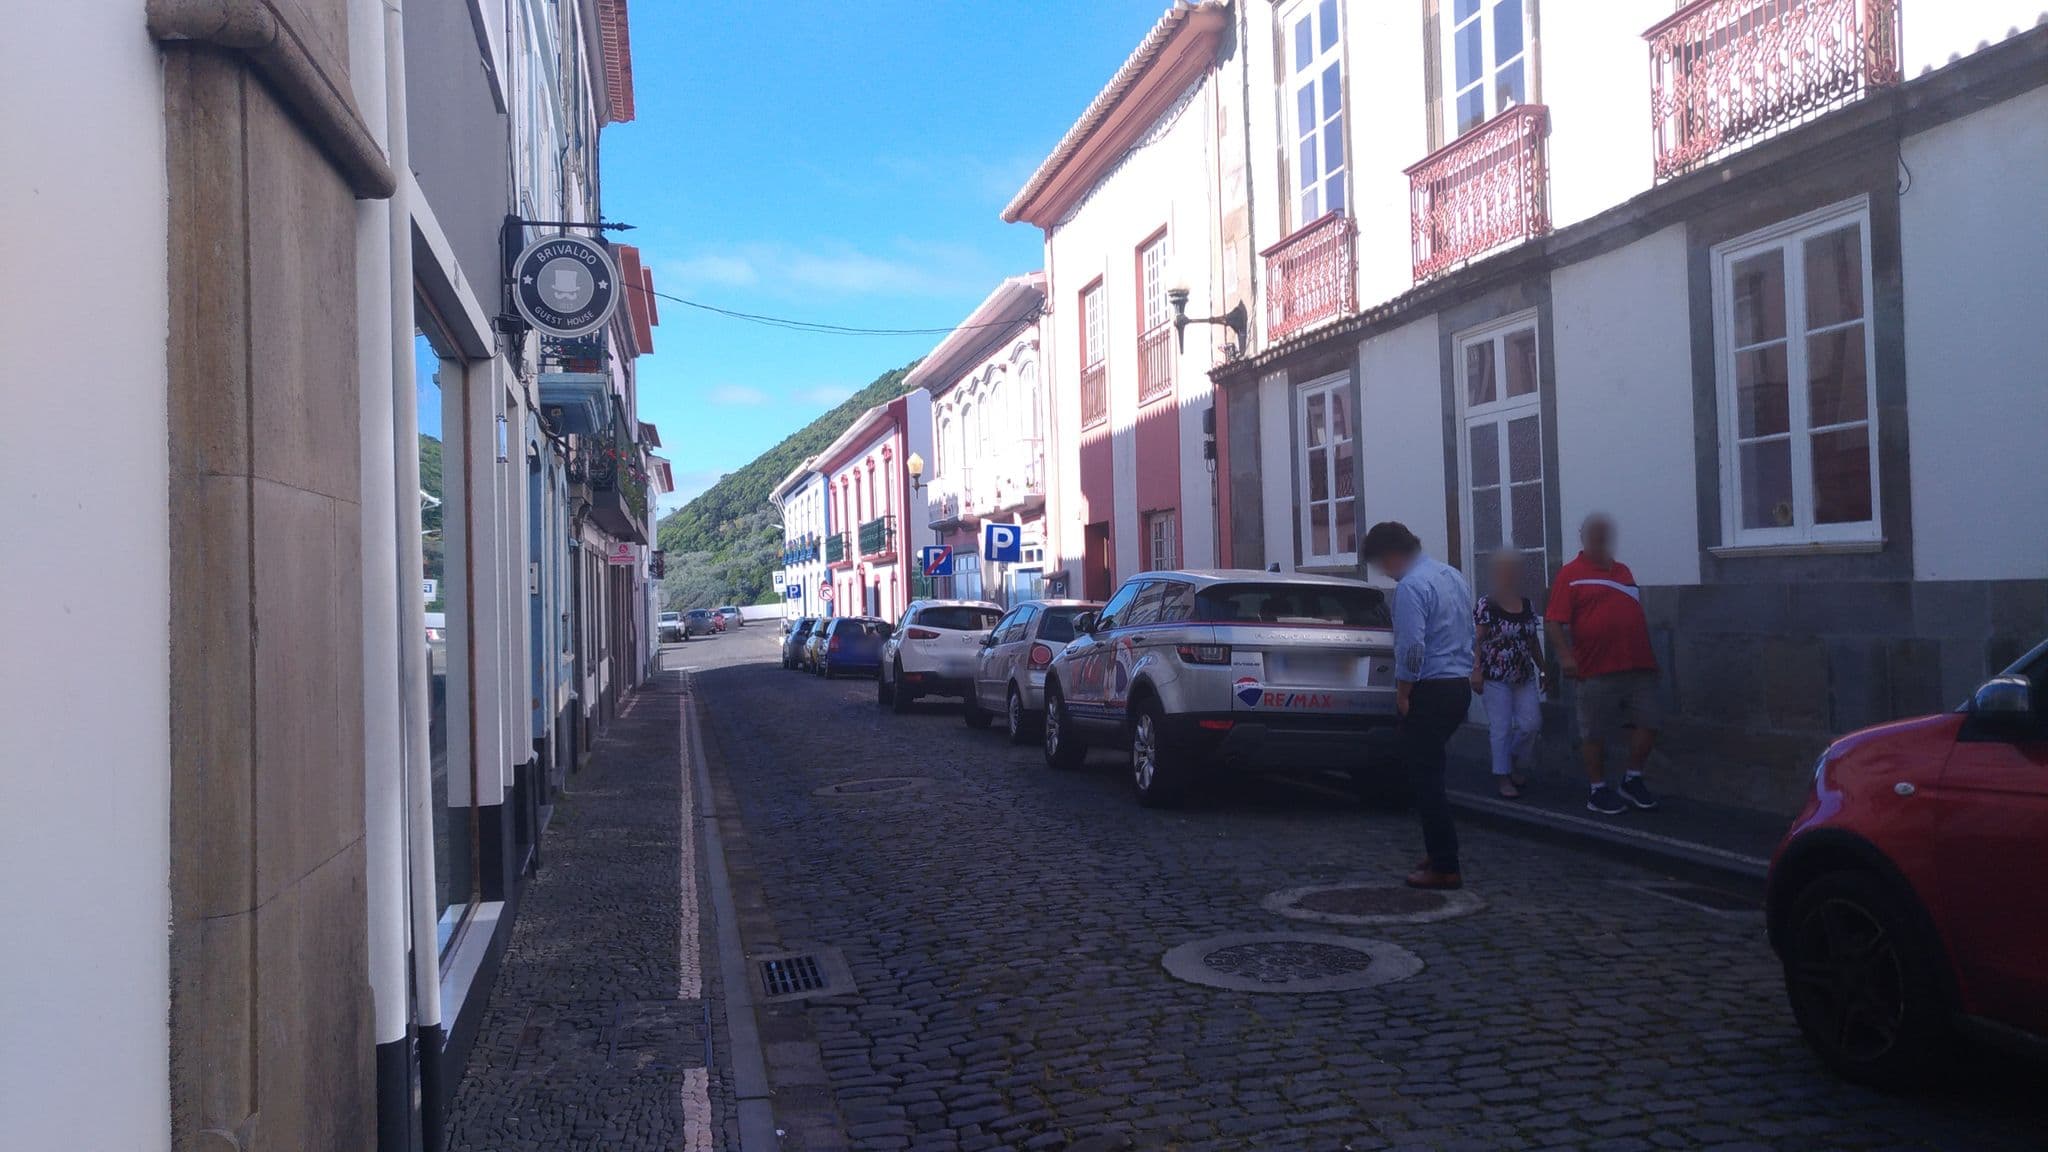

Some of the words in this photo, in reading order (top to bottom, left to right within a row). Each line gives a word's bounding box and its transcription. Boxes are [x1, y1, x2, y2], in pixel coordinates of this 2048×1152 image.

[536, 244, 597, 265] BRIVALDO
[534, 306, 562, 325] GUEST
[566, 310, 594, 326] HOUSE
[991, 526, 1014, 559] P
[789, 585, 799, 598] P
[1263, 691, 1333, 708] RE/MAX
